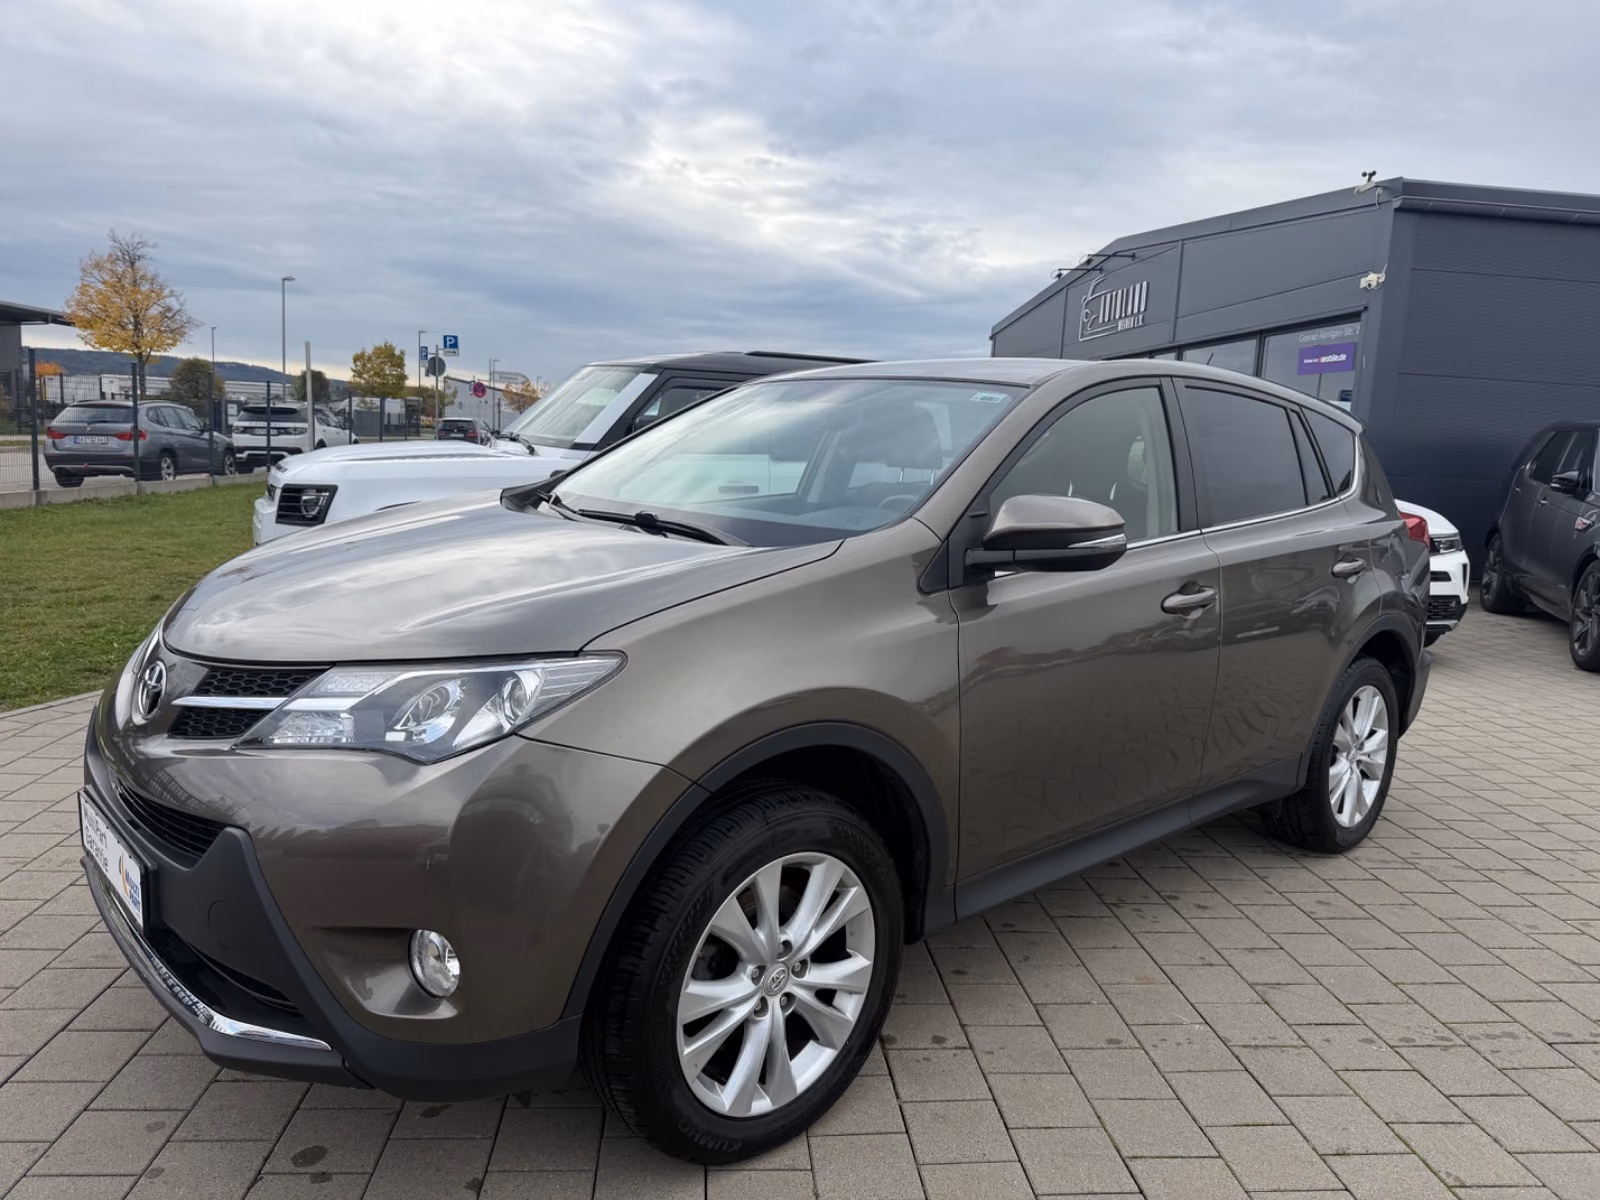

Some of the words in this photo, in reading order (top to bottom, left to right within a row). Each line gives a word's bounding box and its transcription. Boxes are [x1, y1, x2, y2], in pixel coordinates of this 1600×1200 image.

[1099, 281, 1147, 323] AUTOLAND
[446, 336, 455, 349] P
[678, 1117, 742, 1153] KUMHO
